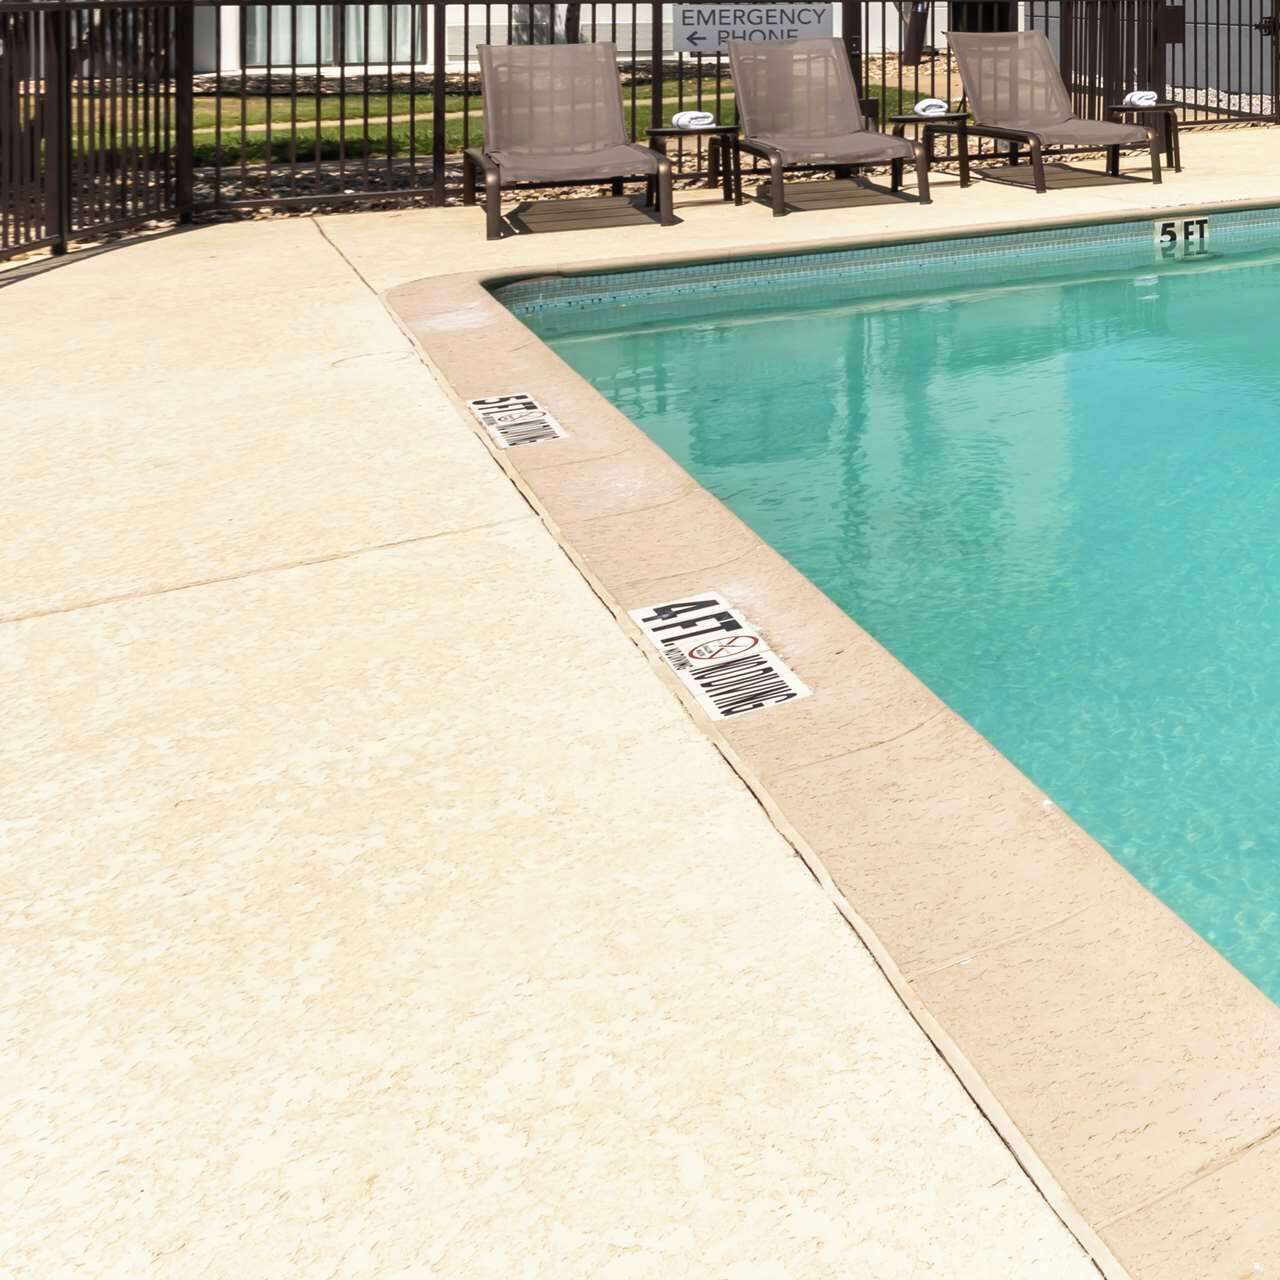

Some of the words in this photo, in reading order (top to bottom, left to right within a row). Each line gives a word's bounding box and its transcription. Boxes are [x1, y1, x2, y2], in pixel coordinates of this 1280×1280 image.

[682, 8, 826, 26] EMERGENCY
[1160, 222, 1177, 243] 5
[1184, 219, 1208, 240] FT
[641, 599, 720, 623] 4
[689, 654, 767, 680] NO
[700, 667, 797, 716] DIVING
